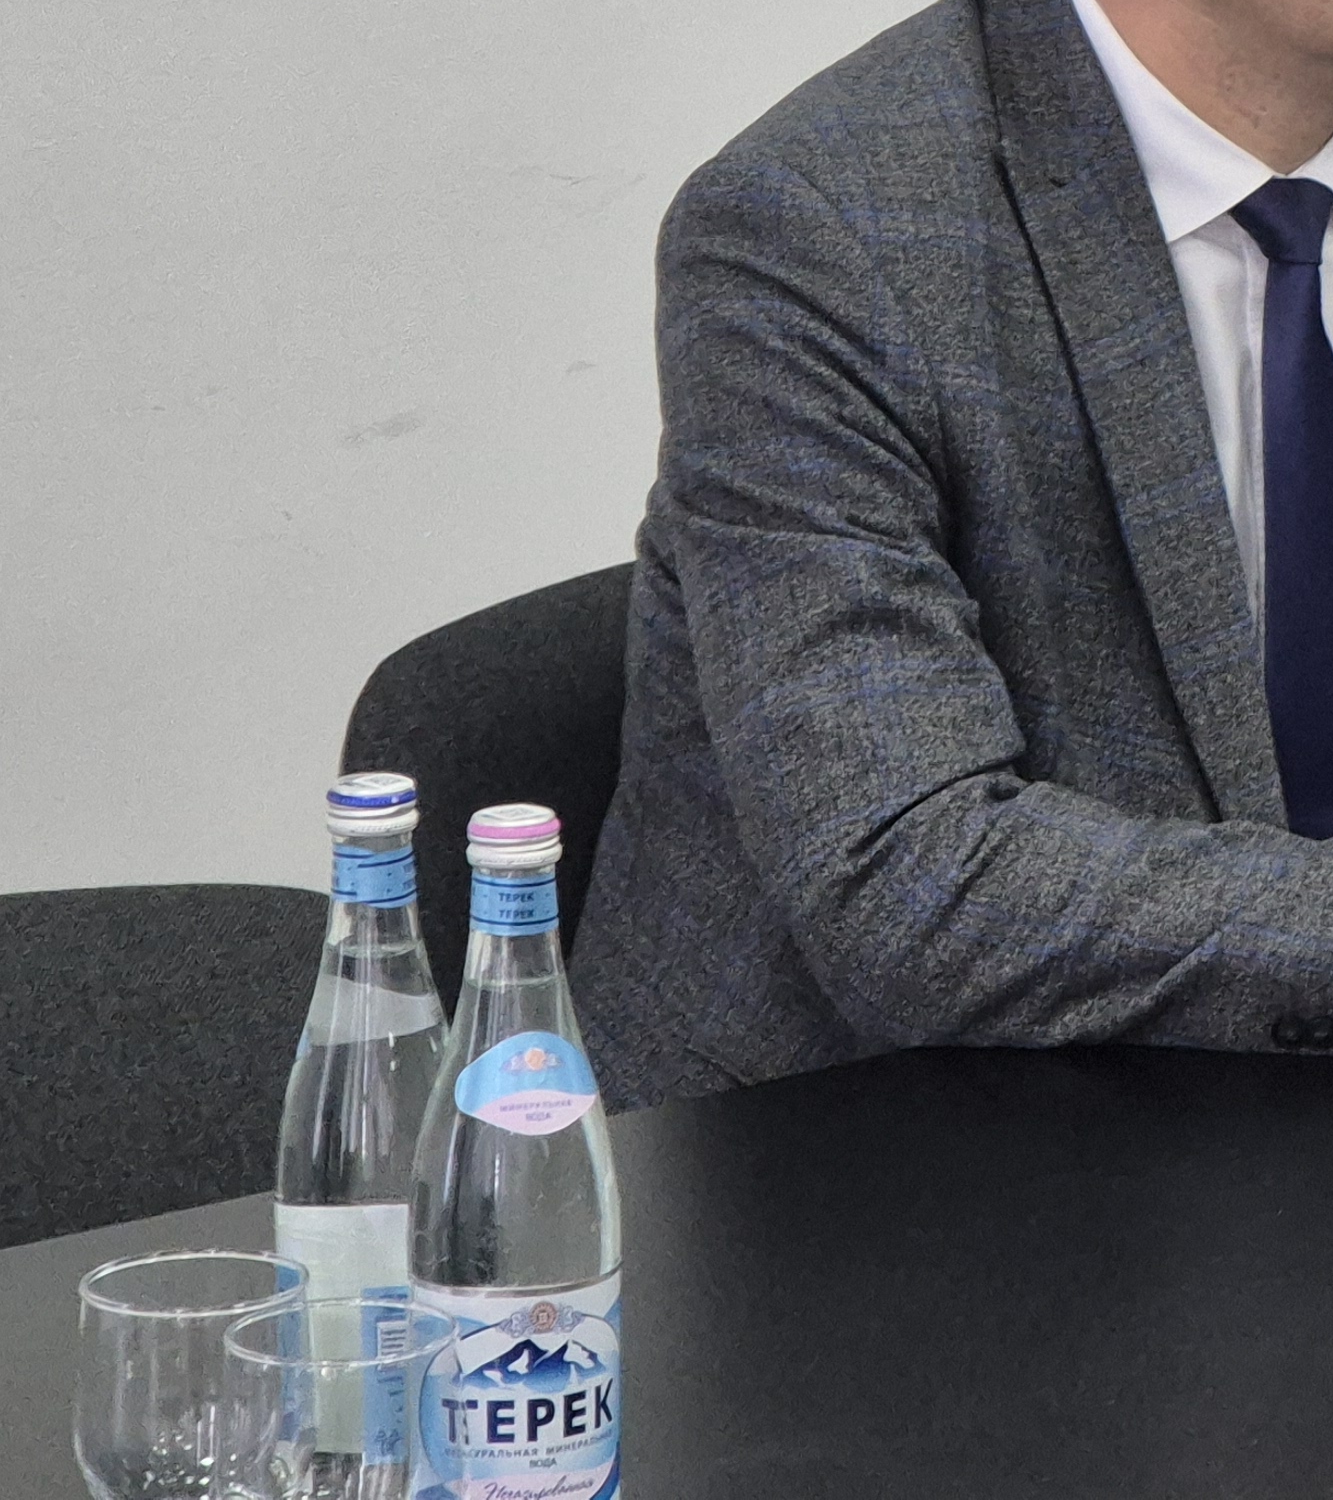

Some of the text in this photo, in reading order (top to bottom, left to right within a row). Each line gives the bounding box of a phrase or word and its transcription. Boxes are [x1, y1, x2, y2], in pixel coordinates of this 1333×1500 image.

[499, 891, 535, 903] ТЕРЕК
[499, 908, 535, 920] ТЕРЕК
[442, 1377, 614, 1445] ТЕРЕК
